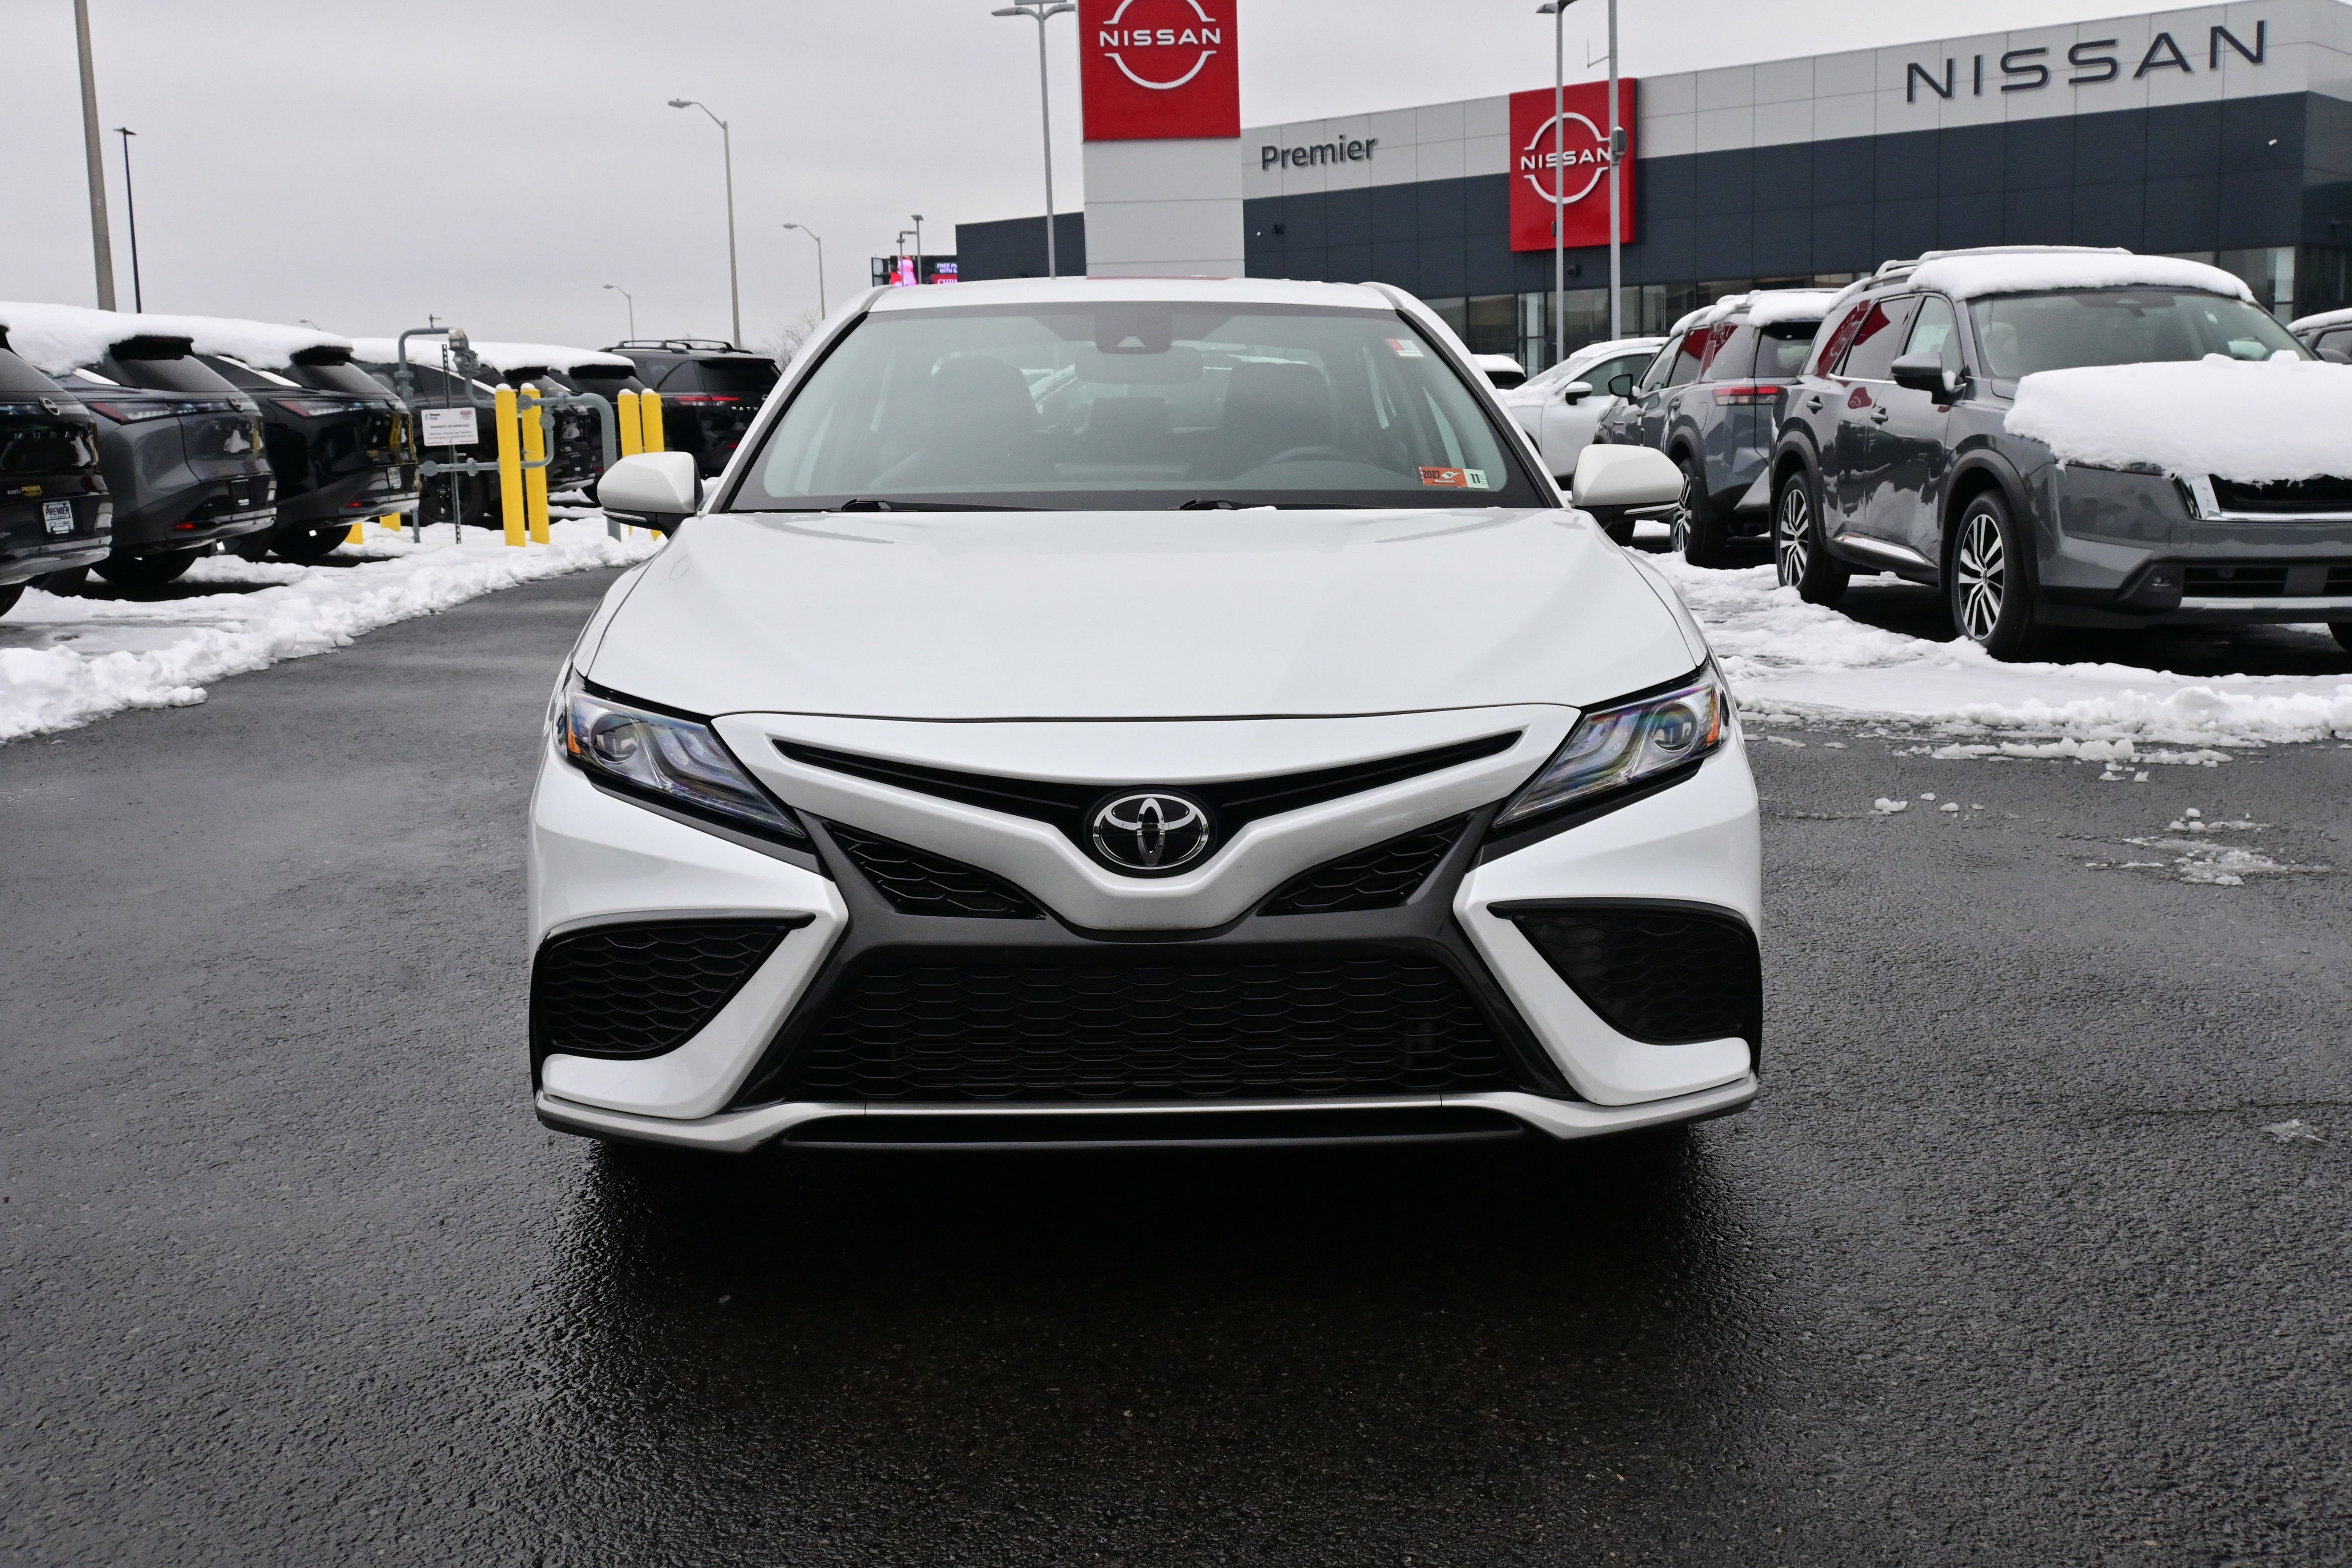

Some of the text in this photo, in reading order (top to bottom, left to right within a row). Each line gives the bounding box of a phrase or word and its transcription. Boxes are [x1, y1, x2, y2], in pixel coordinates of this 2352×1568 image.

[1099, 28, 1220, 47] NISSAN
[1907, 20, 2267, 103] NISSAN
[1261, 135, 1378, 171] Premier
[1521, 147, 1610, 170] NISSAN
[1422, 469, 1440, 479] 2027
[1470, 473, 1481, 484] 11
[45, 506, 70, 516] PREMIER
